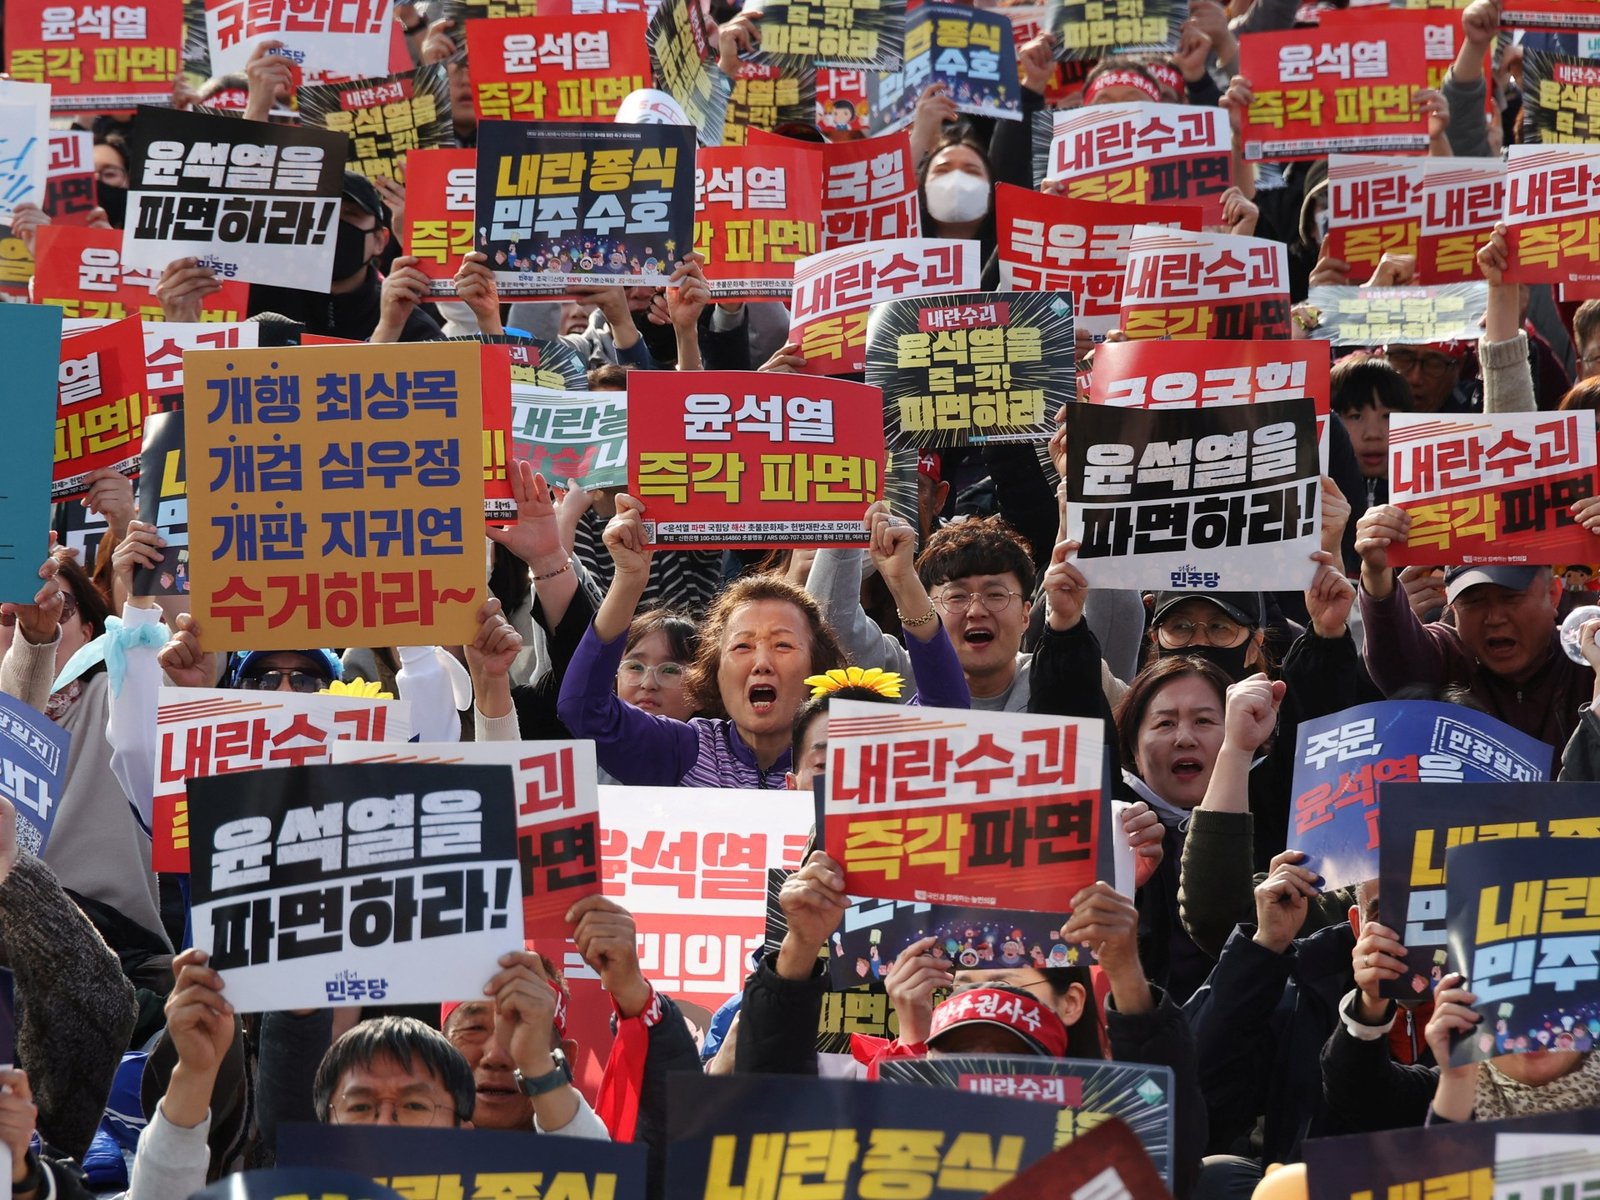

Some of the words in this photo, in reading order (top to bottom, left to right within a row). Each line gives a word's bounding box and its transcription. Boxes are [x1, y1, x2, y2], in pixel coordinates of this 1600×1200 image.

[41, 6, 147, 41] 윤석열
[935, 20, 1001, 52] 종식
[10, 48, 84, 83] 즉각
[94, 46, 177, 82] 파면!
[504, 30, 610, 73] 윤석열
[934, 47, 1001, 81] 수호
[1278, 40, 1388, 83] 윤석열
[1559, 66, 1600, 85] 내란수
[346, 82, 404, 106] 내란수괴
[478, 80, 548, 120] 즉각
[1248, 90, 1322, 129] 즉각
[142, 141, 325, 191] 윤석열을
[1057, 111, 1216, 173] 내란수괴
[495, 151, 586, 197] 내란
[588, 148, 678, 192] 종식
[1151, 156, 1229, 200] 파면
[1509, 165, 1600, 216] 내란
[134, 196, 337, 245] 파면하라!
[490, 195, 580, 241] 민주
[584, 189, 673, 239] 수호
[725, 219, 816, 263] 파면!
[1011, 218, 1180, 268] 극우국
[794, 244, 963, 318] 내란수괴
[1124, 246, 1278, 299] 내란수괴
[926, 304, 997, 328] 내란수괴
[897, 327, 1042, 369] 윤석열을
[207, 373, 301, 424] 개행
[317, 370, 458, 421] 최상목
[928, 364, 1011, 392] 즉-각!
[683, 393, 835, 443] 윤석열
[898, 389, 1045, 432] 파면하라
[209, 442, 303, 492] 개검
[319, 439, 461, 490] 심우정
[638, 452, 745, 503] 즉각
[760, 453, 877, 504] 파면!
[1082, 421, 1297, 496] 윤석열을
[1393, 416, 1579, 494] 내란수괴
[211, 510, 307, 561] 개판
[321, 507, 464, 557] 지귀연
[663, 524, 689, 533] <윤석열
[691, 524, 706, 532] 파면
[708, 524, 729, 532] 국힘당
[731, 523, 746, 532] 해산
[748, 523, 789, 532] 촛불문화제>
[791, 522, 834, 531] 헌법재판소로
[836, 522, 861, 531] 모이자!
[1077, 481, 1318, 559] 파면하라!
[1407, 494, 1500, 550] 즉각
[1502, 474, 1594, 534] 파면
[210, 570, 476, 632] 수거하라~
[1170, 572, 1220, 588] 민주당
[832, 724, 1078, 805] 내란수괴
[1304, 718, 1383, 770] 주문,
[1448, 729, 1531, 782] 만장일치
[211, 789, 483, 893] 윤석열을
[844, 813, 968, 880] 즉각
[968, 799, 1093, 868] 파면
[209, 867, 513, 972] 파면하라!
[1475, 877, 1600, 945] 내란
[325, 978, 389, 1001] 민주당
[1471, 935, 1600, 1005] 민주
[704, 1128, 859, 1200] 내란
